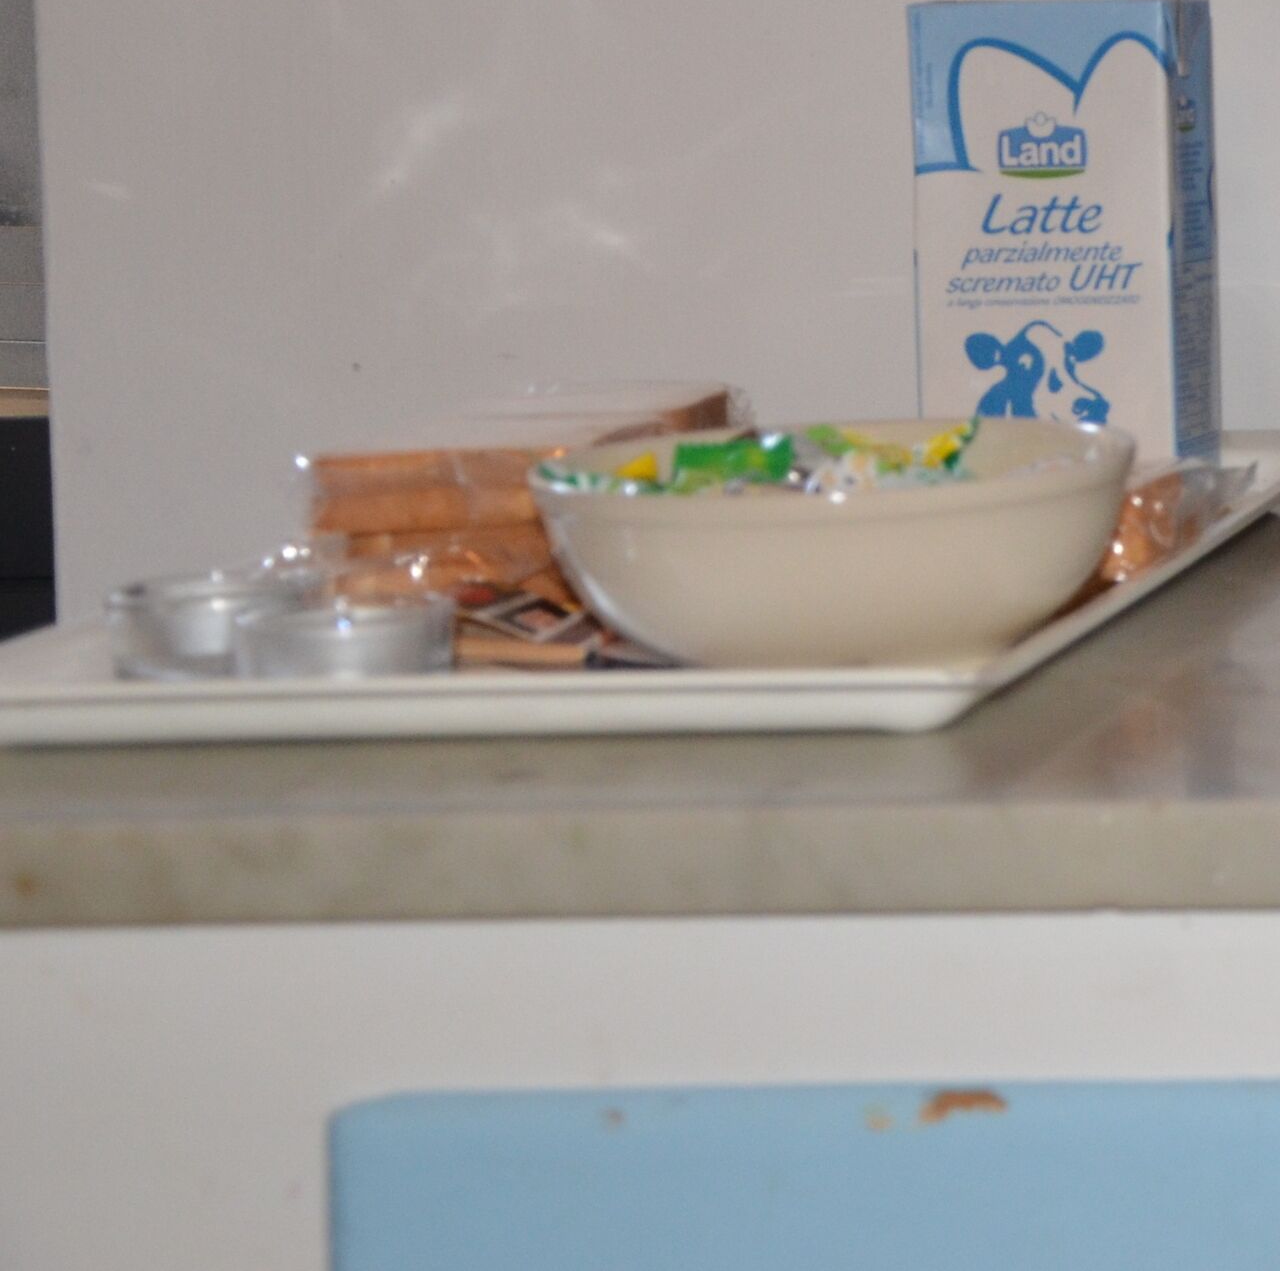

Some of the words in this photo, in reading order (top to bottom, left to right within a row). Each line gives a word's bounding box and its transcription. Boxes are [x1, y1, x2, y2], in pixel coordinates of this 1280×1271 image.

[1001, 133, 1083, 167] Land
[981, 193, 1104, 235] Latte
[961, 240, 1123, 271] parzialmente
[946, 272, 1060, 294] scremato
[1069, 261, 1143, 292] UHT
